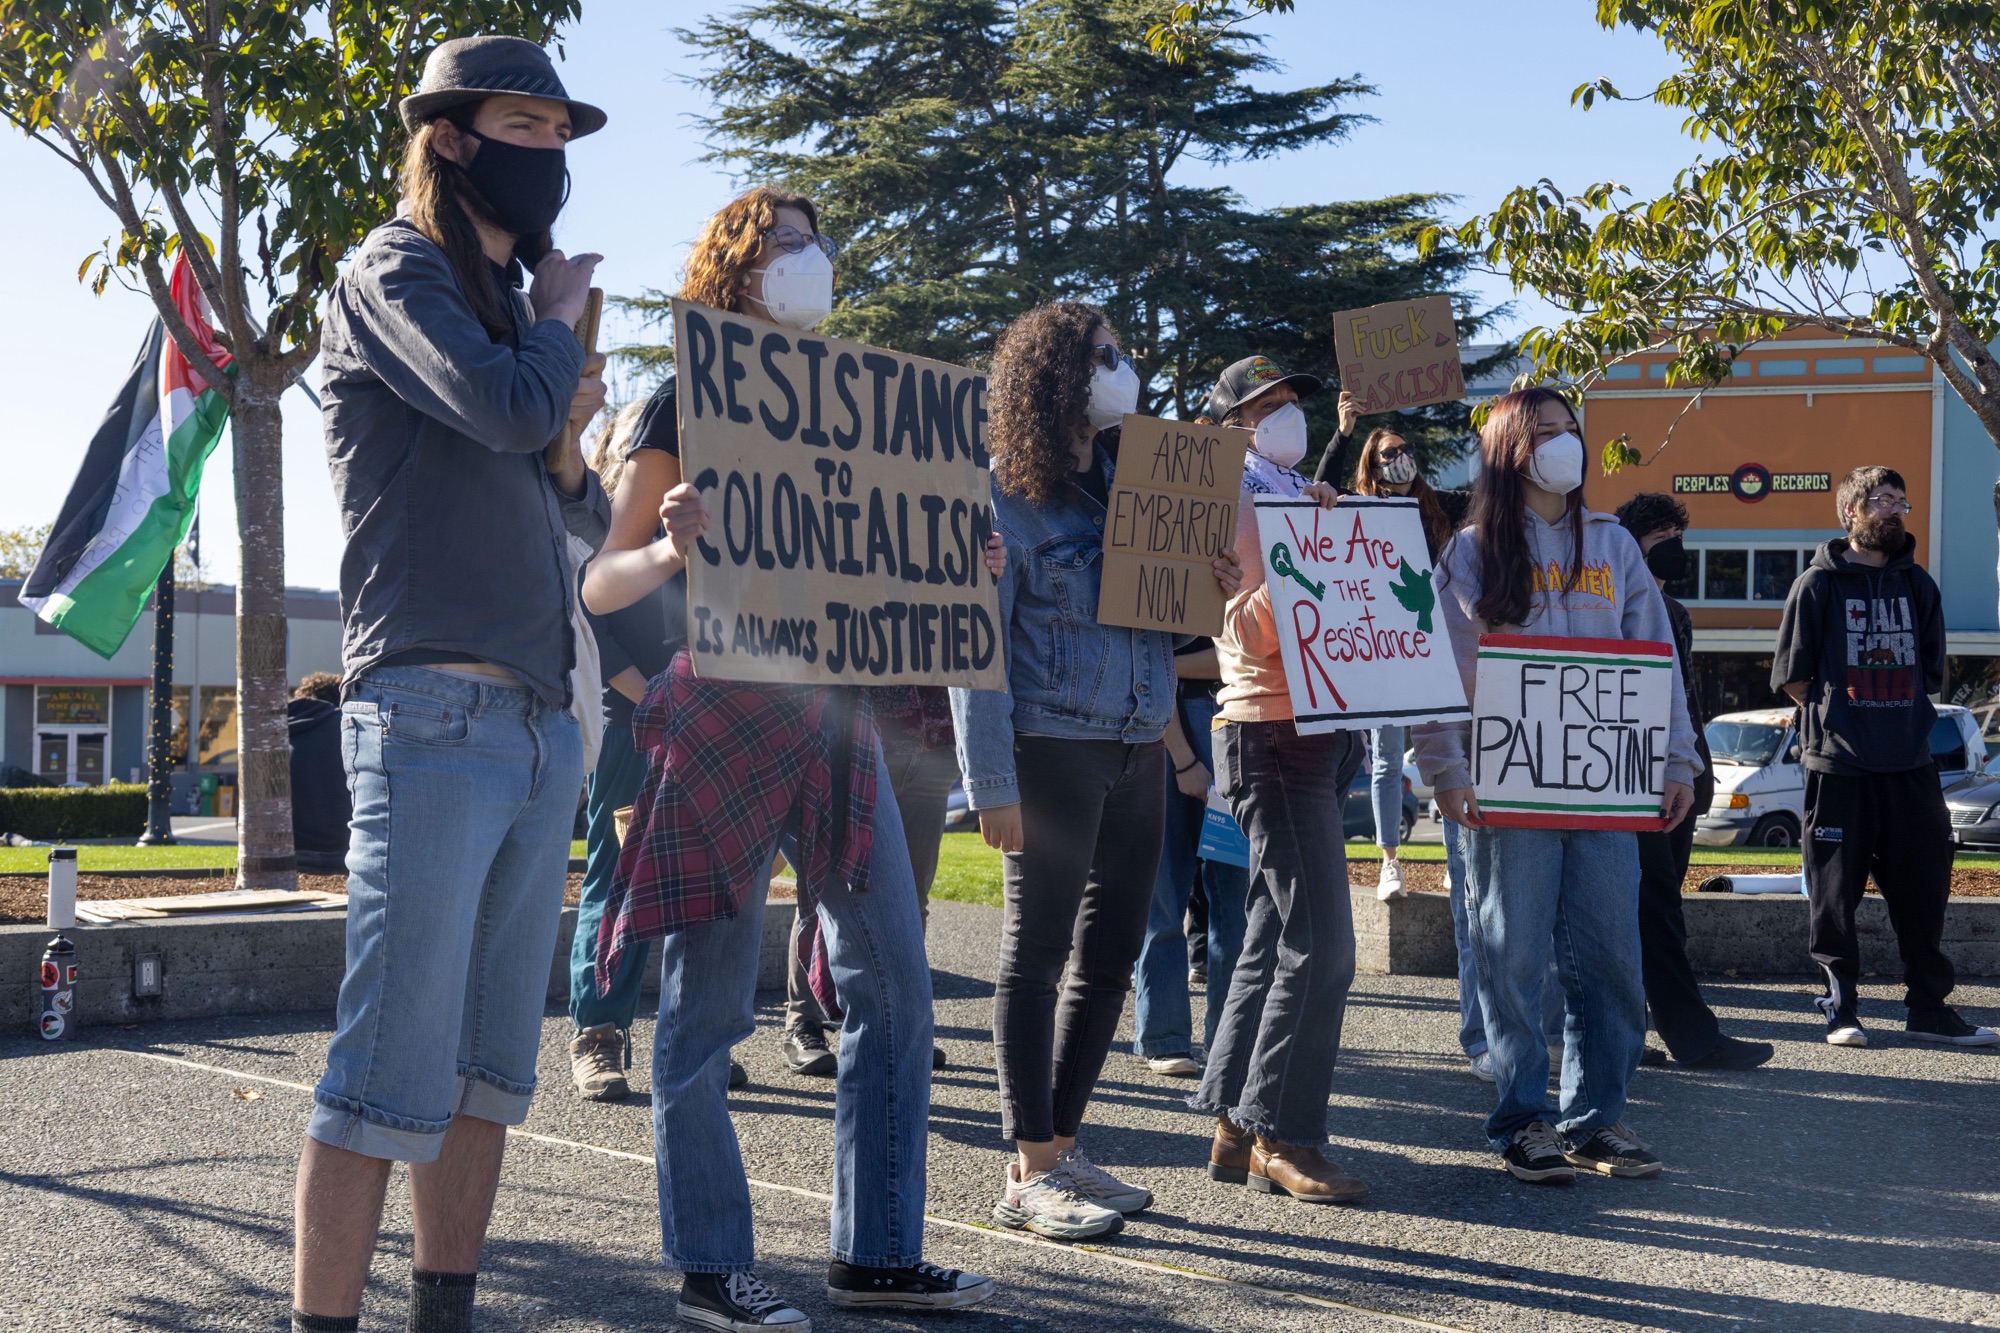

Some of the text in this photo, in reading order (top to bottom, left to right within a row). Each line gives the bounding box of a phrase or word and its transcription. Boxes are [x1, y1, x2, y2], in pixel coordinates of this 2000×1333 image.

[686, 310, 990, 469] RESISTANCE
[1345, 358, 1463, 412] FASCISM
[815, 458, 852, 497] TO
[1151, 431, 1220, 487] ARMS
[1772, 474, 1829, 491] RECORDS
[694, 468, 997, 588] COLONIALISM
[1112, 491, 1230, 558] EMBARGO
[1284, 507, 1400, 570] We Are
[1137, 564, 1189, 625] NOW
[1333, 579, 1376, 601] THE
[1845, 597, 1913, 632] CALI
[731, 613, 818, 664] ALWAYS
[825, 601, 996, 676] JUSTIFIED
[1292, 600, 1431, 712] Resistance
[1846, 632, 1916, 666] FOR
[1521, 663, 1641, 723] FREE
[1847, 667, 1915, 701] NIA
[1848, 699, 1884, 708] CALIFORNIA
[1476, 716, 1665, 795] PALESTINE
[1207, 812, 1226, 824] KN95
